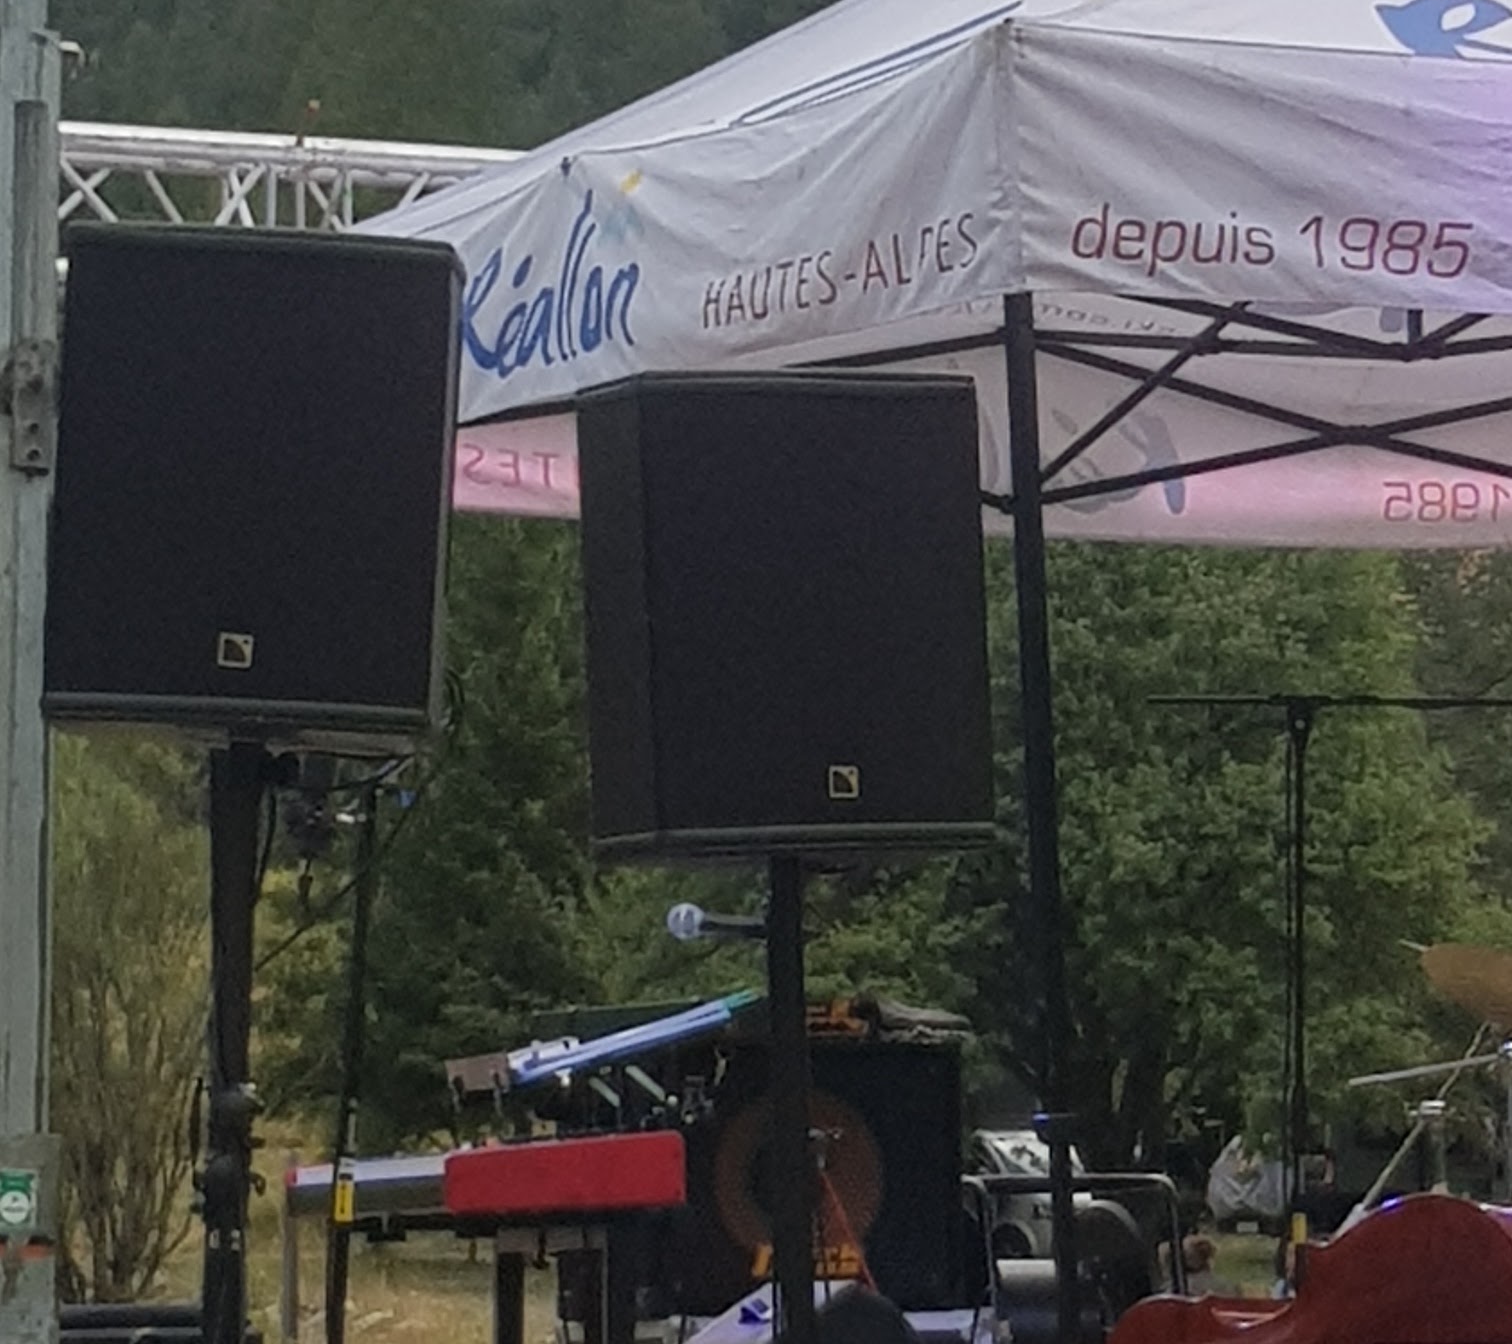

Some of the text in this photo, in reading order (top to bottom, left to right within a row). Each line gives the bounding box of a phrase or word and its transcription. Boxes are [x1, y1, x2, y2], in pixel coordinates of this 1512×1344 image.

[461, 188, 640, 379] Réallon
[1071, 202, 1475, 279] depuis 1985
